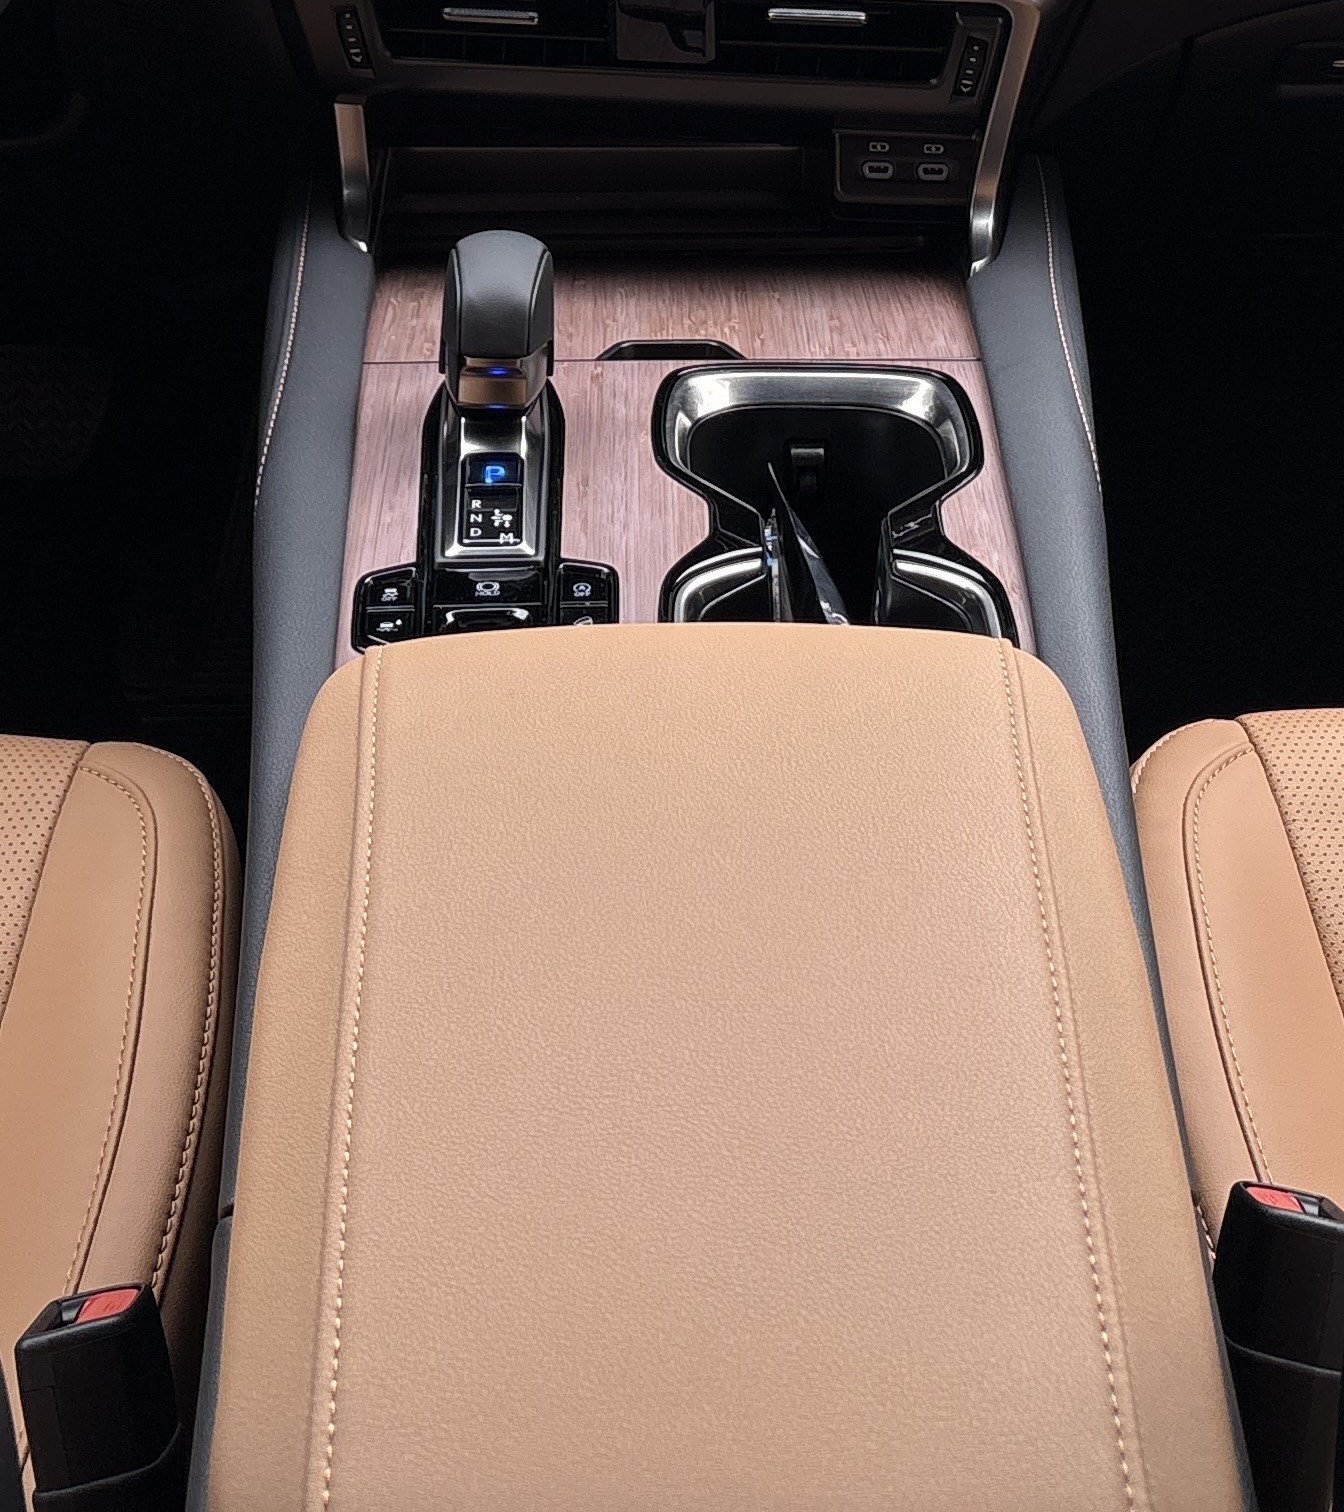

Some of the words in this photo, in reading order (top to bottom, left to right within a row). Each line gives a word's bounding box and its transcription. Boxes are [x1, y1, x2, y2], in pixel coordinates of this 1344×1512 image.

[483, 464, 506, 485] P
[470, 498, 483, 510] R
[469, 513, 483, 524] N
[469, 527, 482, 538] D
[499, 532, 515, 544] M
